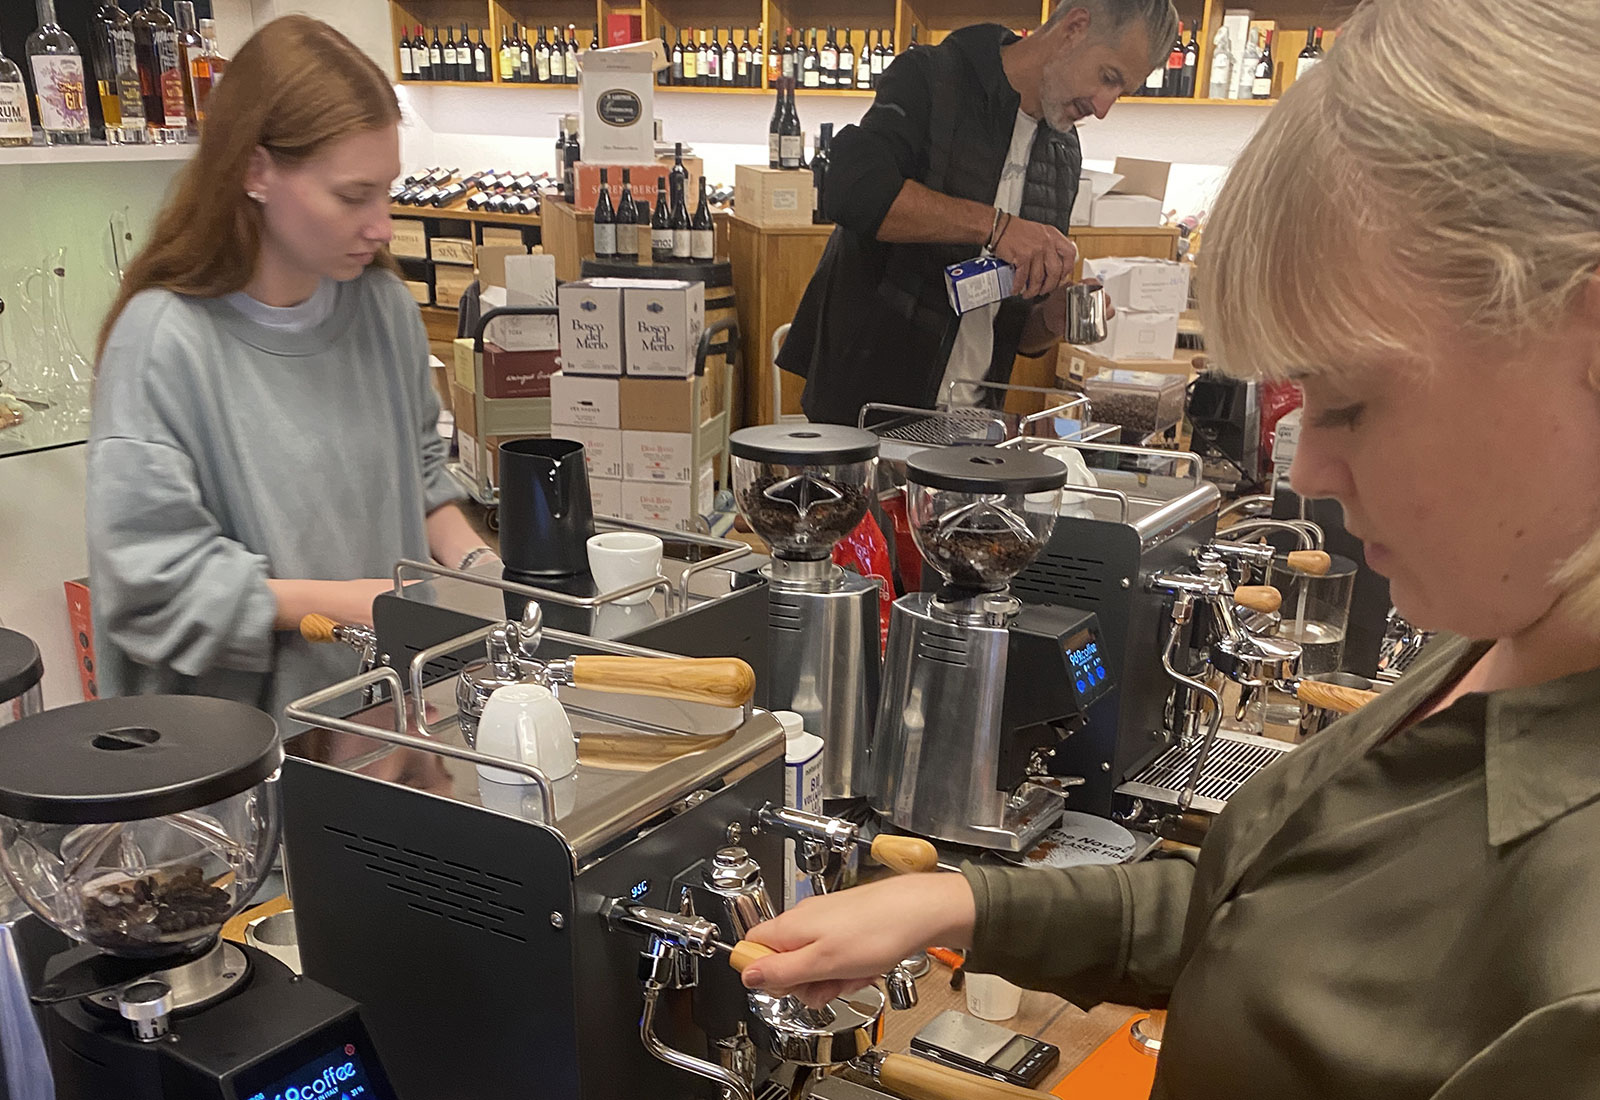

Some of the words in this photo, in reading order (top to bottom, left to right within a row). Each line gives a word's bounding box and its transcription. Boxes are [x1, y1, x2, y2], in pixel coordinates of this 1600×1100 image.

[572, 319, 604, 331] Bosco
[638, 321, 670, 334] Bosco
[585, 329, 601, 342] del
[651, 331, 667, 343] del
[576, 337, 609, 350] Merlo
[642, 338, 674, 352] Merlo
